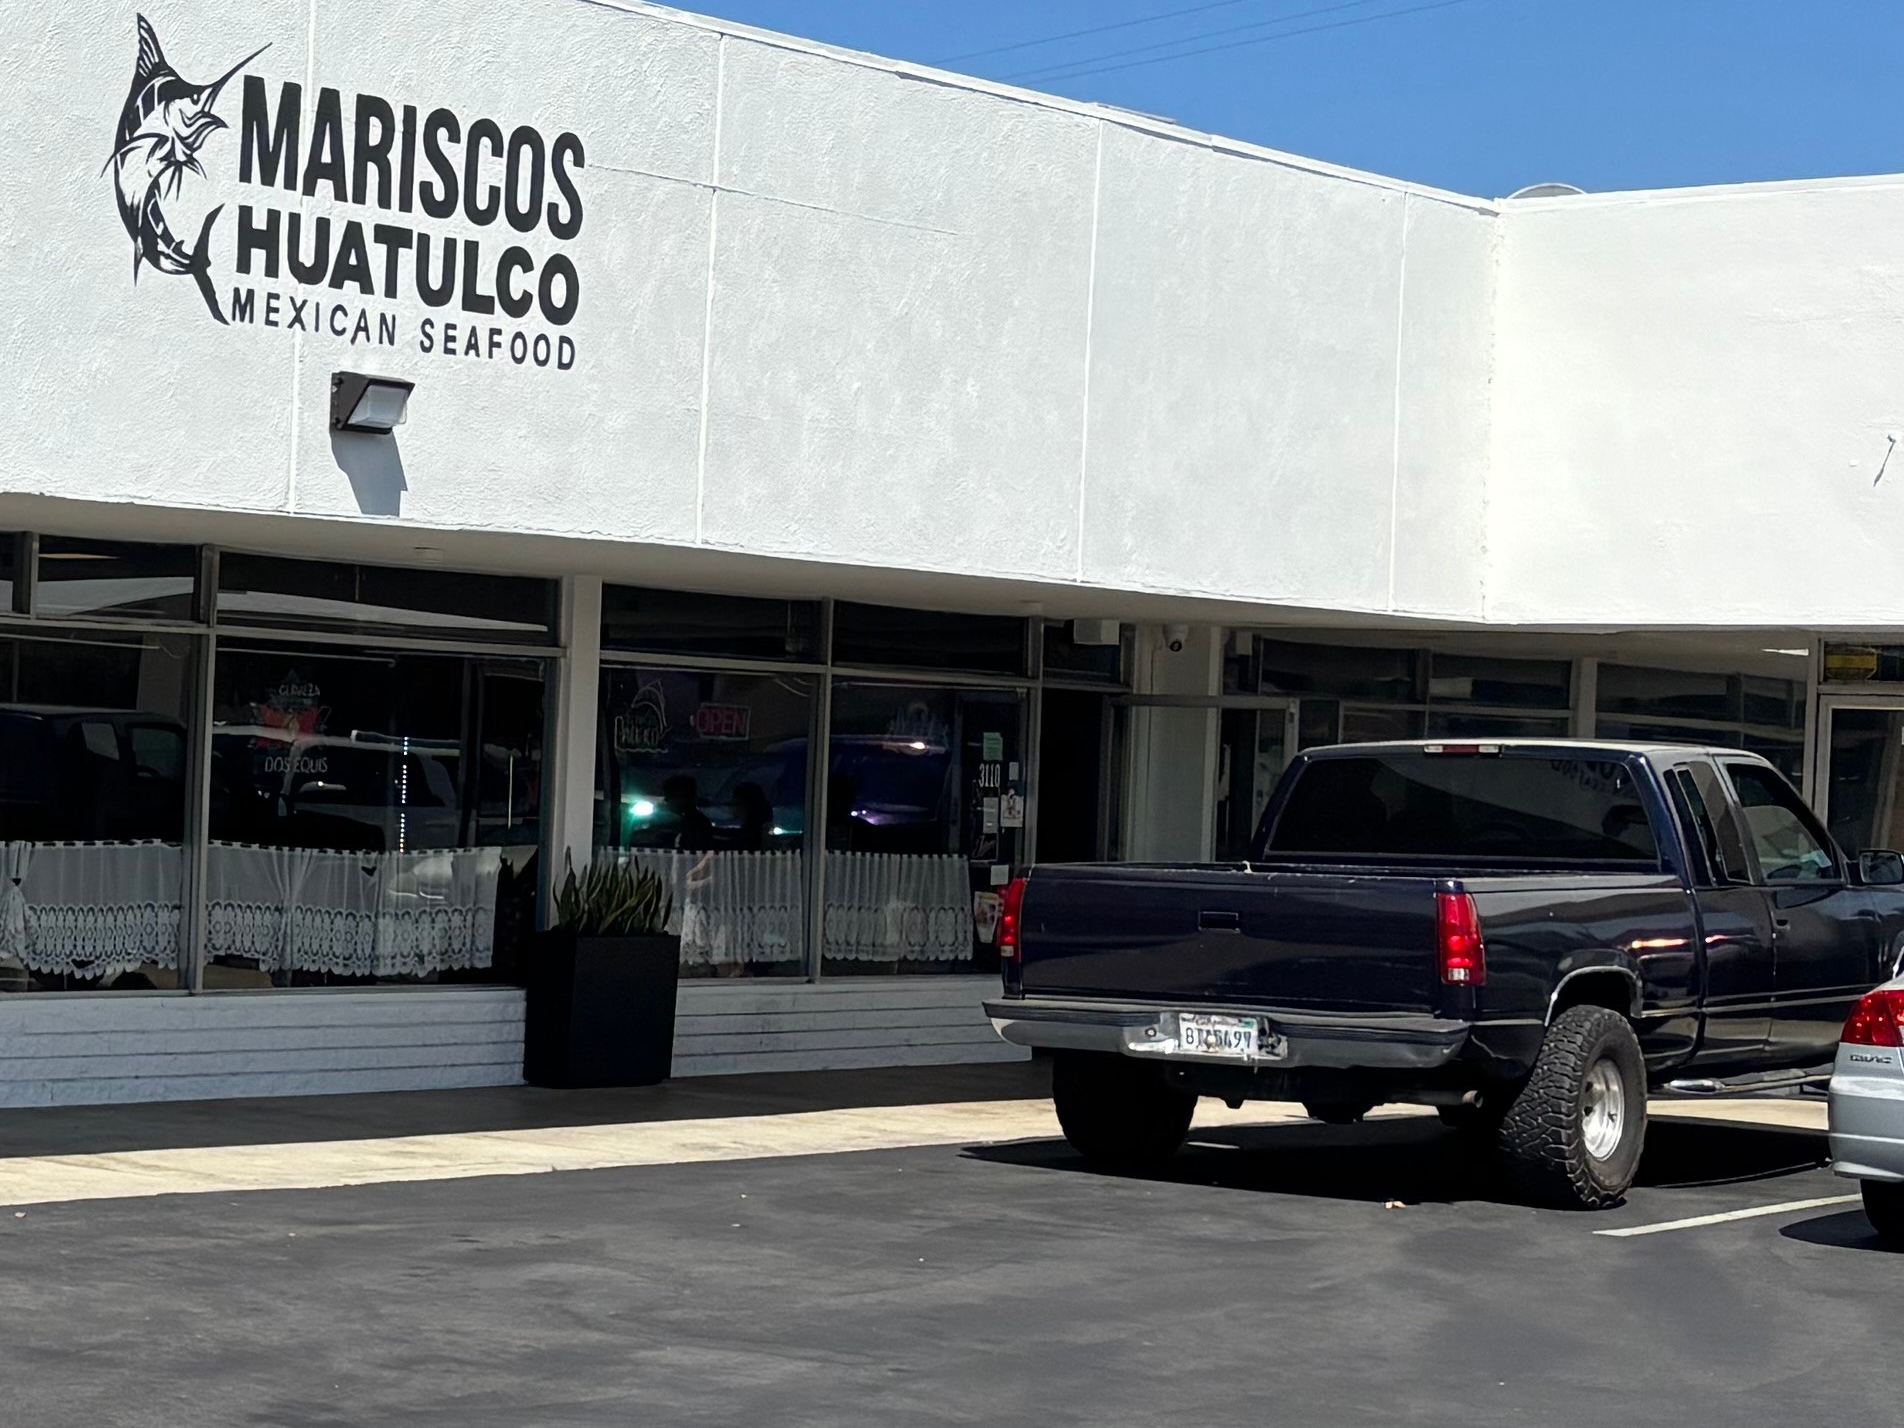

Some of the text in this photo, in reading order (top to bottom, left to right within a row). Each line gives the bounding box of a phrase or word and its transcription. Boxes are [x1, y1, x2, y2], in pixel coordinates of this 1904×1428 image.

[239, 74, 585, 240] MARISCOS
[236, 204, 579, 326] HUATULCO
[231, 287, 576, 370] MEXICAN SEAFOOD
[697, 707, 748, 735] OPEN
[265, 757, 328, 773] DOS EQUIS
[978, 764, 1000, 788] 3110
